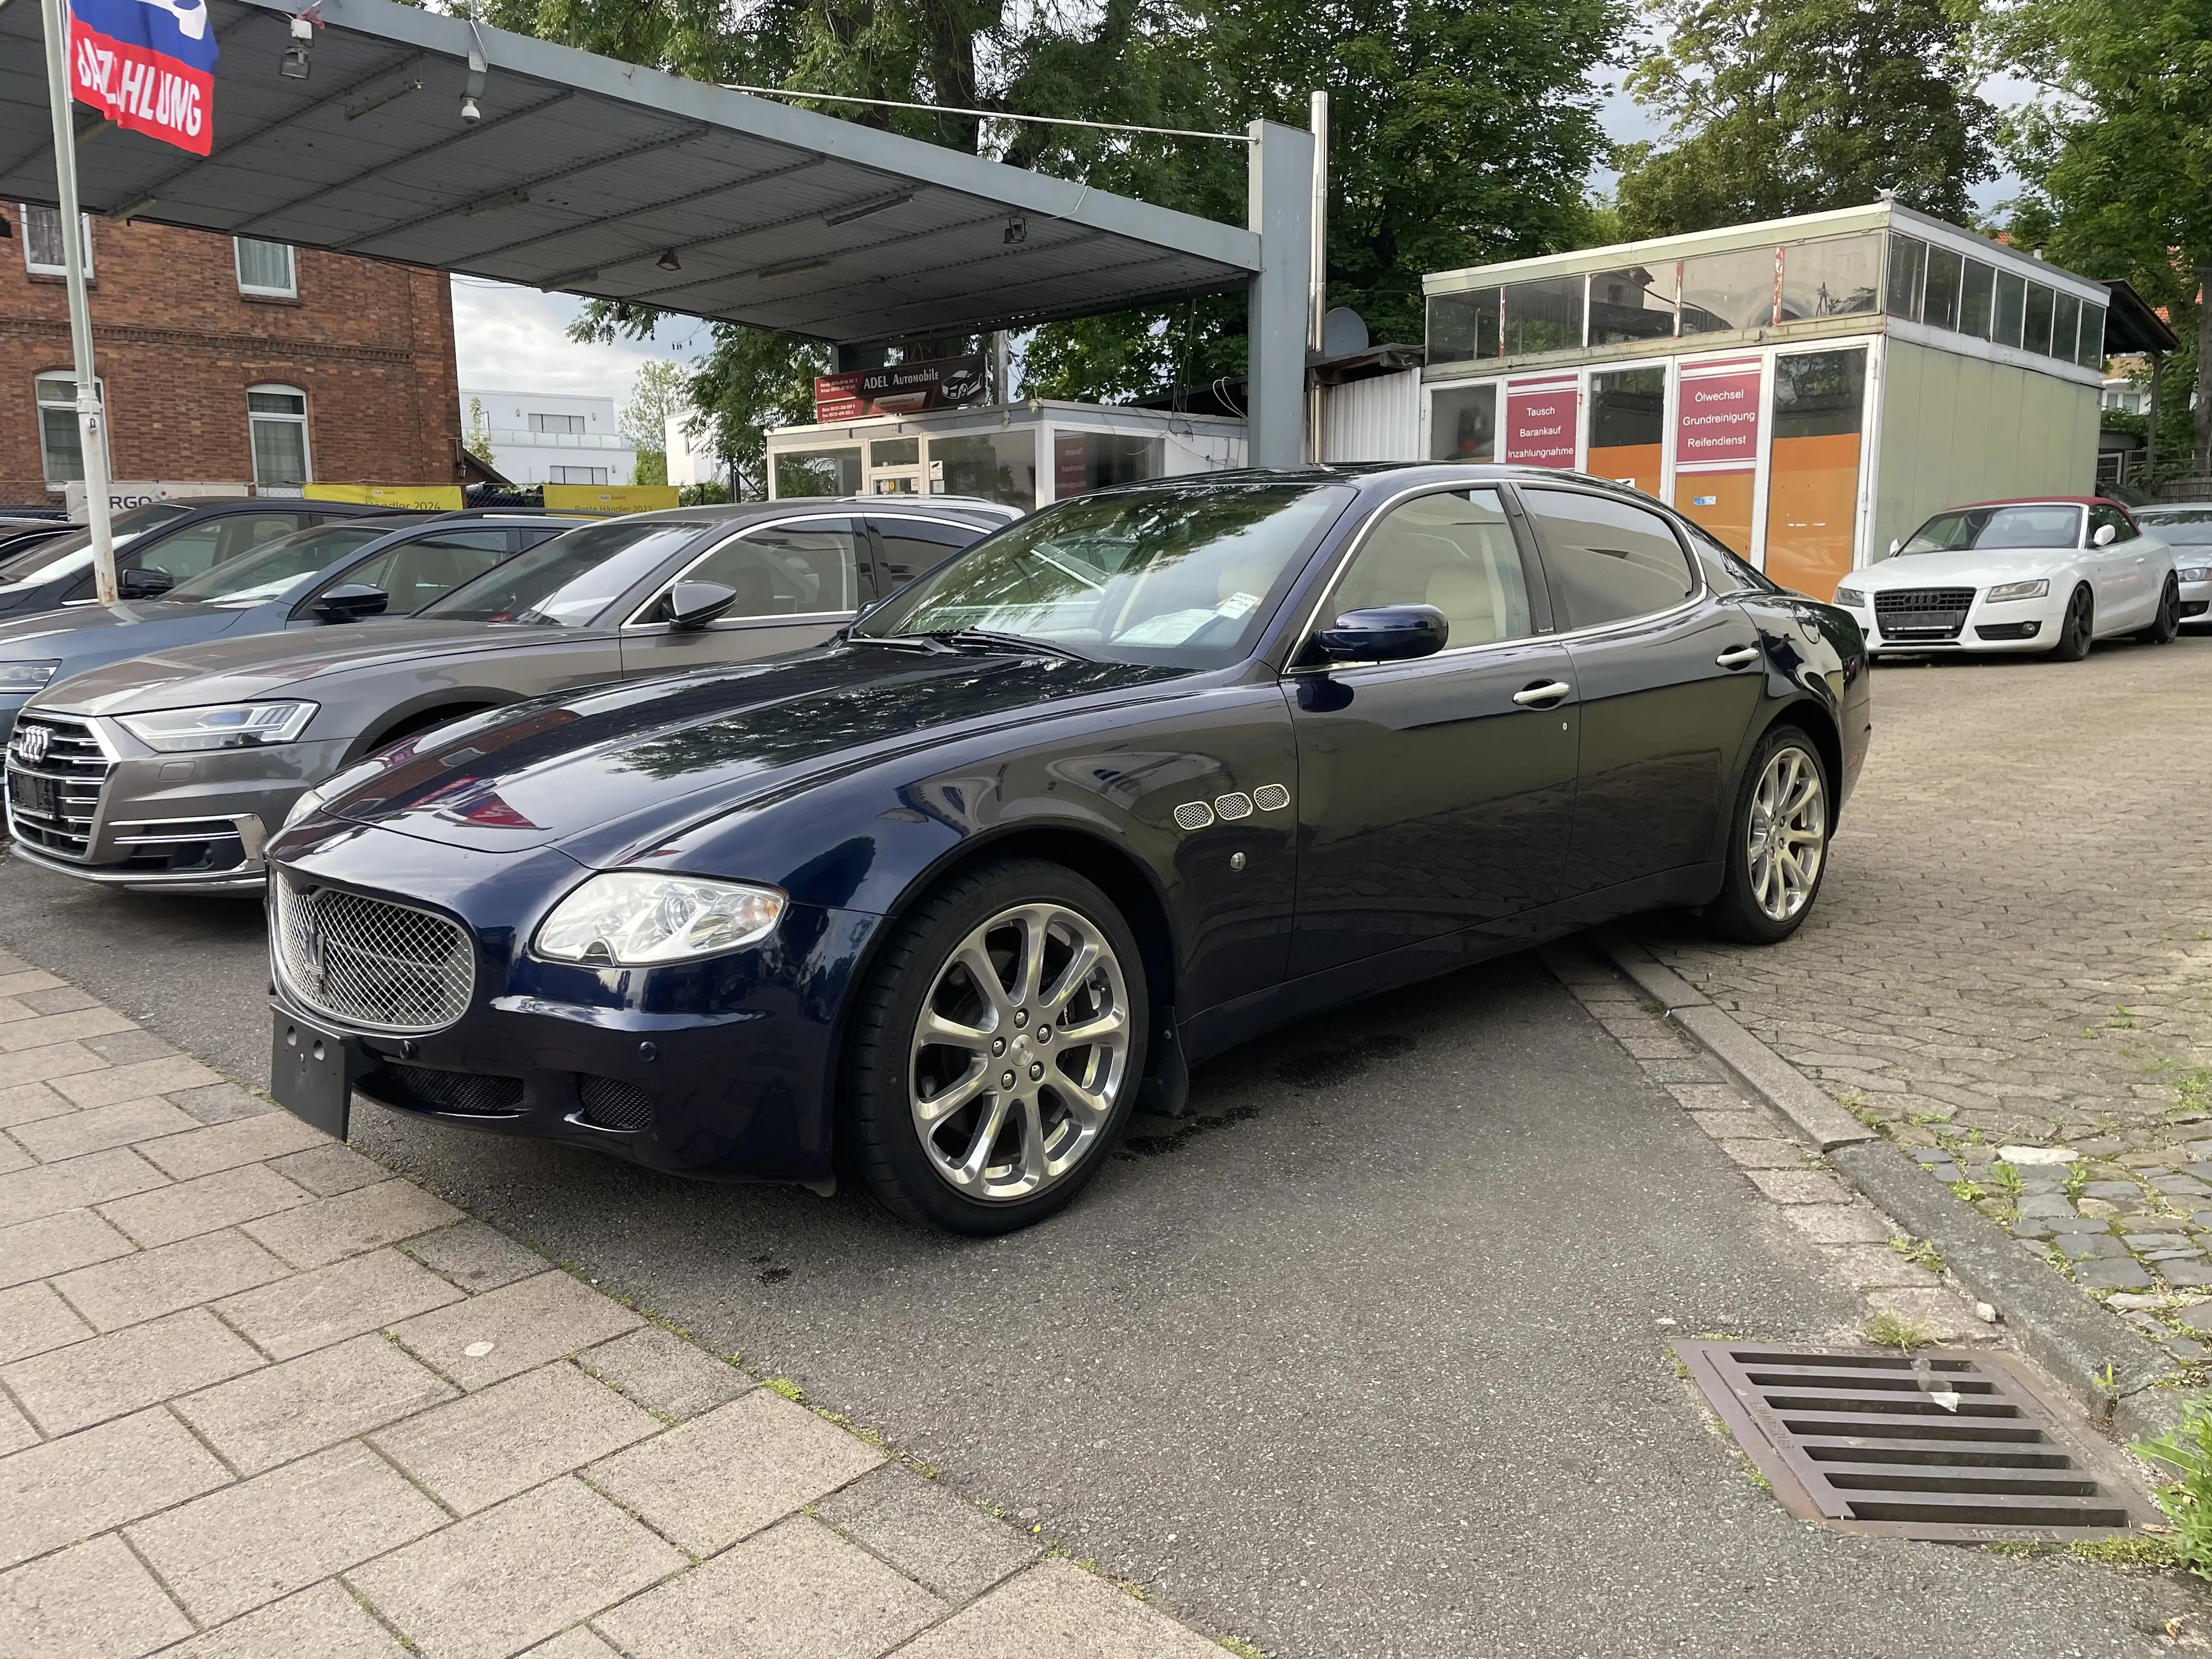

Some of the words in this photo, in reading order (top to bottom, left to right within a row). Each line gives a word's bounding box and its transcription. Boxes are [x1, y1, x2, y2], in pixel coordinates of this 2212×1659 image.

[863, 375, 889, 390] ADEL
[1695, 389, 1744, 403] Ölwechsel
[1527, 407, 1555, 416] Tausch
[1683, 412, 1755, 426] Grundreinigung
[1520, 425, 1562, 437] Barankauf
[1687, 435, 1746, 448] Reifendienst
[1508, 447, 1574, 459] Inzahlungnahme
[83, 496, 152, 509] RGO
[414, 502, 441, 510] 2024
